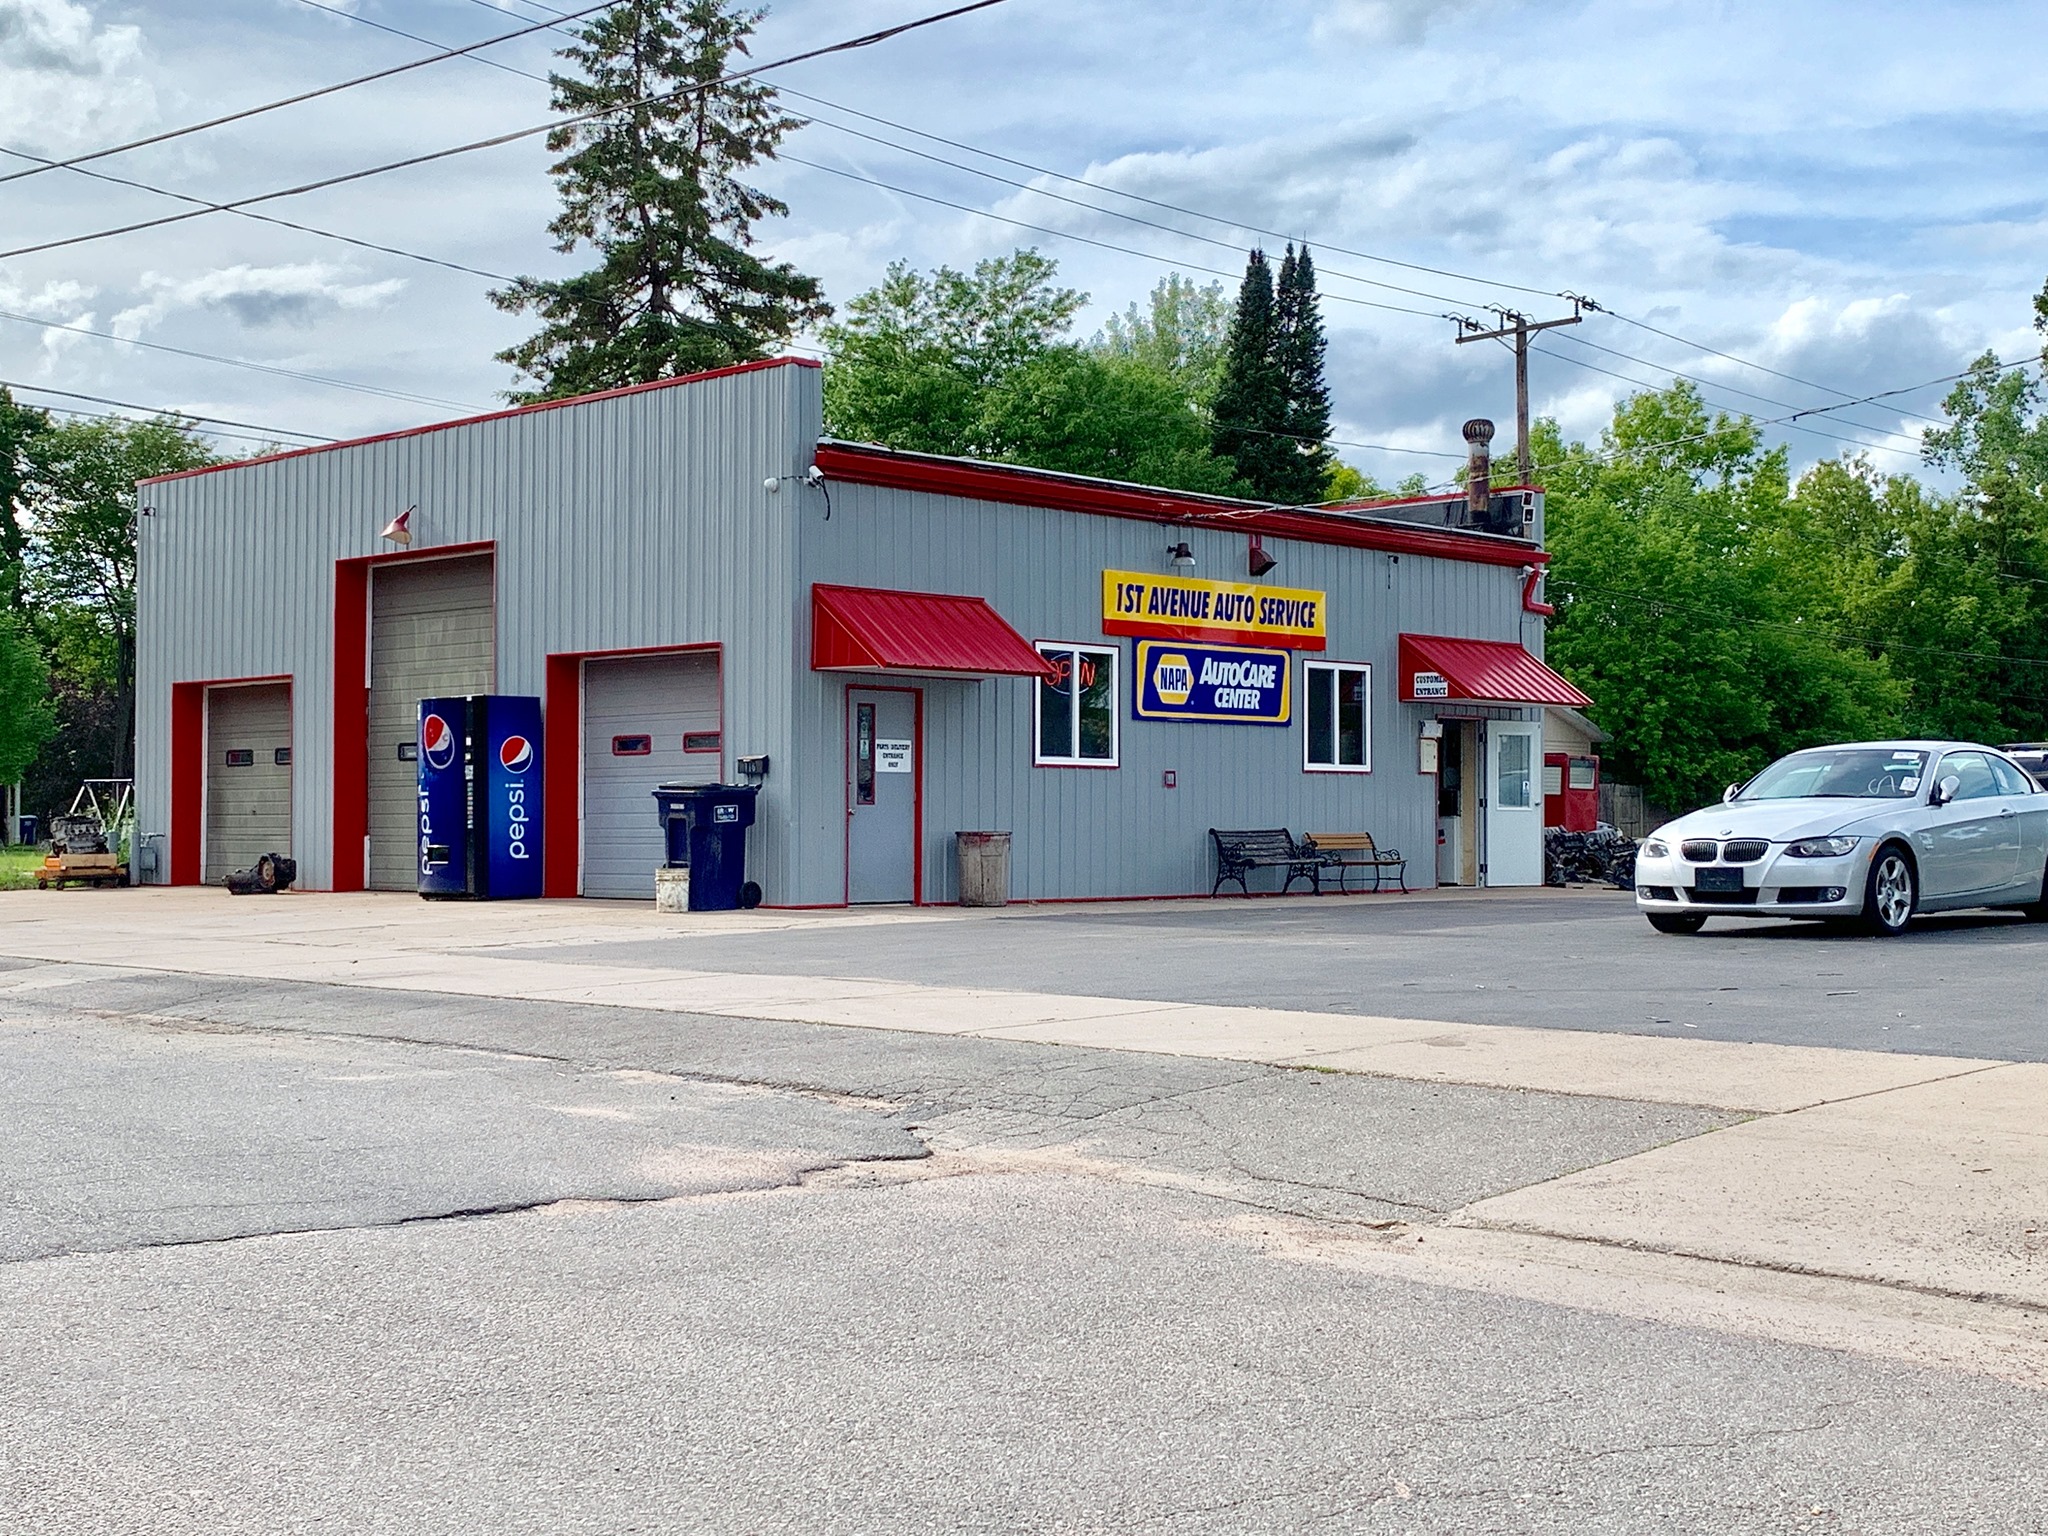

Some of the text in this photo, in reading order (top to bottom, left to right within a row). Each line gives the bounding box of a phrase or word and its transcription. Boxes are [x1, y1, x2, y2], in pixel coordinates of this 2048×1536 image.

[1116, 583, 1317, 628] 1ST AVENUE AUTO SERVICE
[1160, 667, 1188, 691] NAPA
[1214, 687, 1260, 710] CENTER
[1416, 687, 1447, 696] ENTRANCE
[505, 782, 529, 859] pepsi
